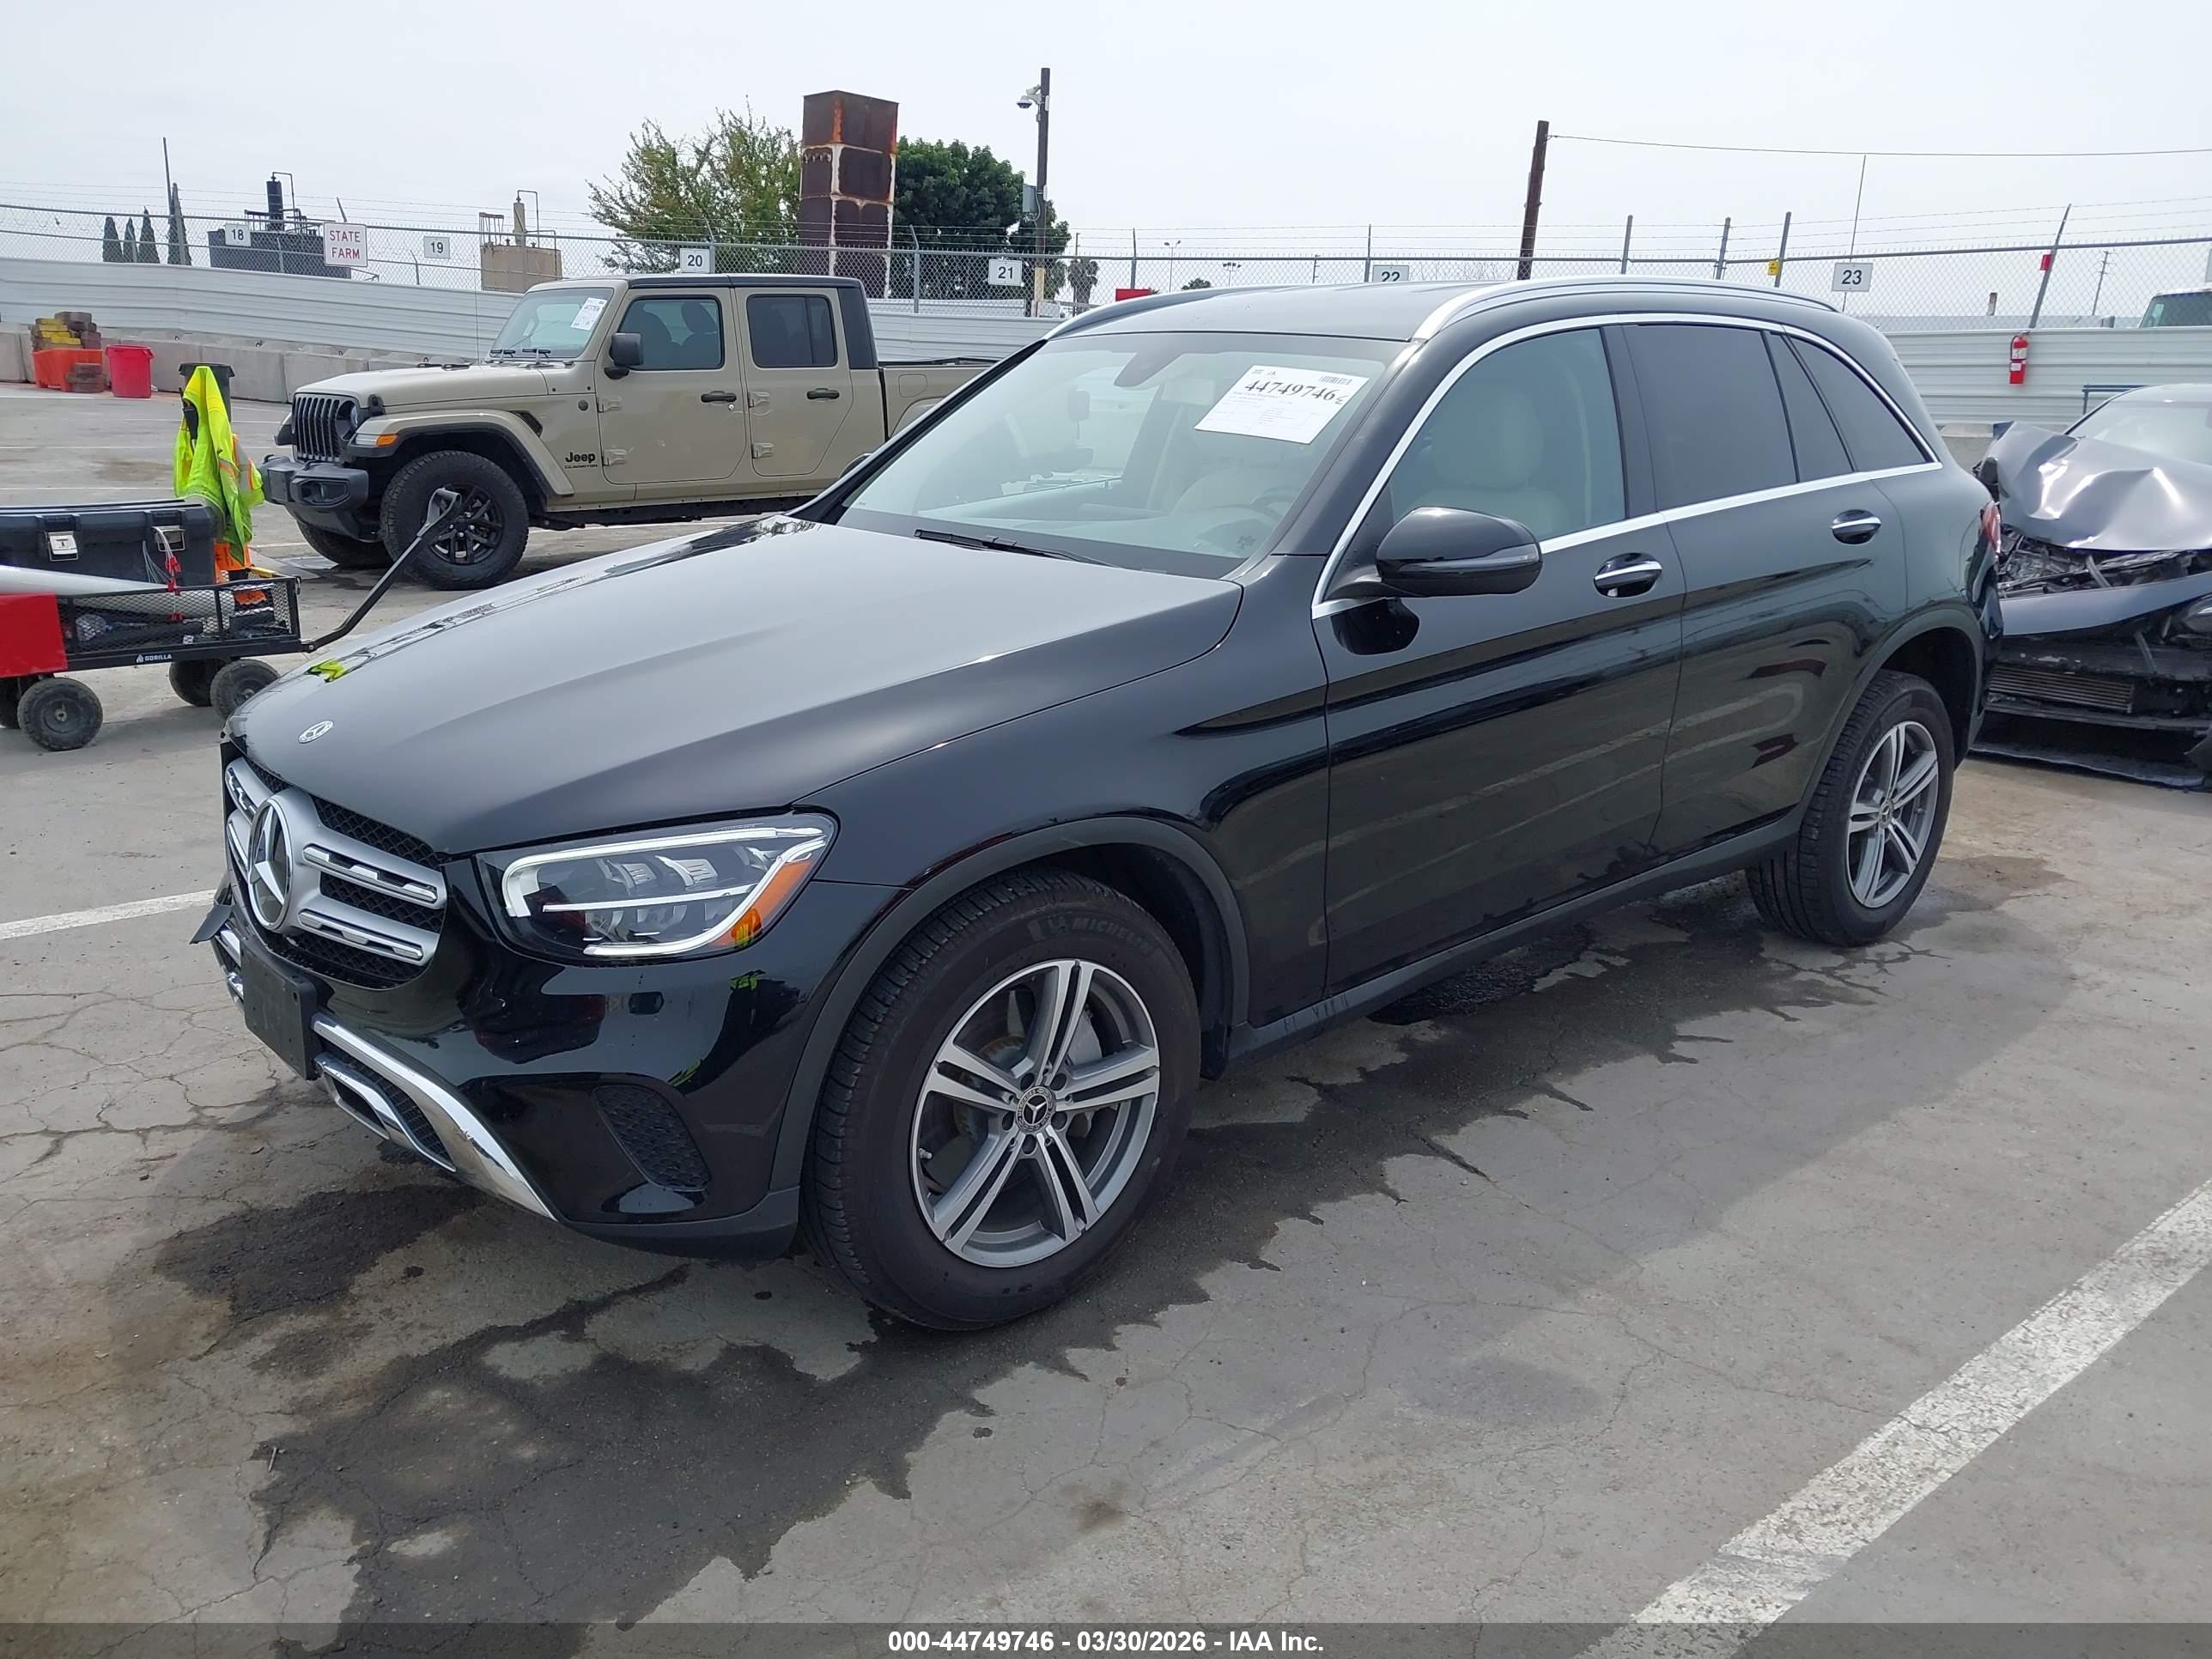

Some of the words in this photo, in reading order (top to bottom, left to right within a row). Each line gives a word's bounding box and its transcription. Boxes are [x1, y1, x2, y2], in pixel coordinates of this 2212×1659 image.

[231, 228, 245, 240] 18
[329, 230, 361, 242] STATE
[331, 247, 361, 259] FARM
[430, 242, 444, 253] 19
[687, 254, 702, 267] 20
[998, 266, 1013, 279] 21
[1381, 270, 1401, 282] 22
[1841, 270, 1863, 285] 23
[1244, 380, 1340, 401] 44749746
[565, 452, 596, 464] Jeep
